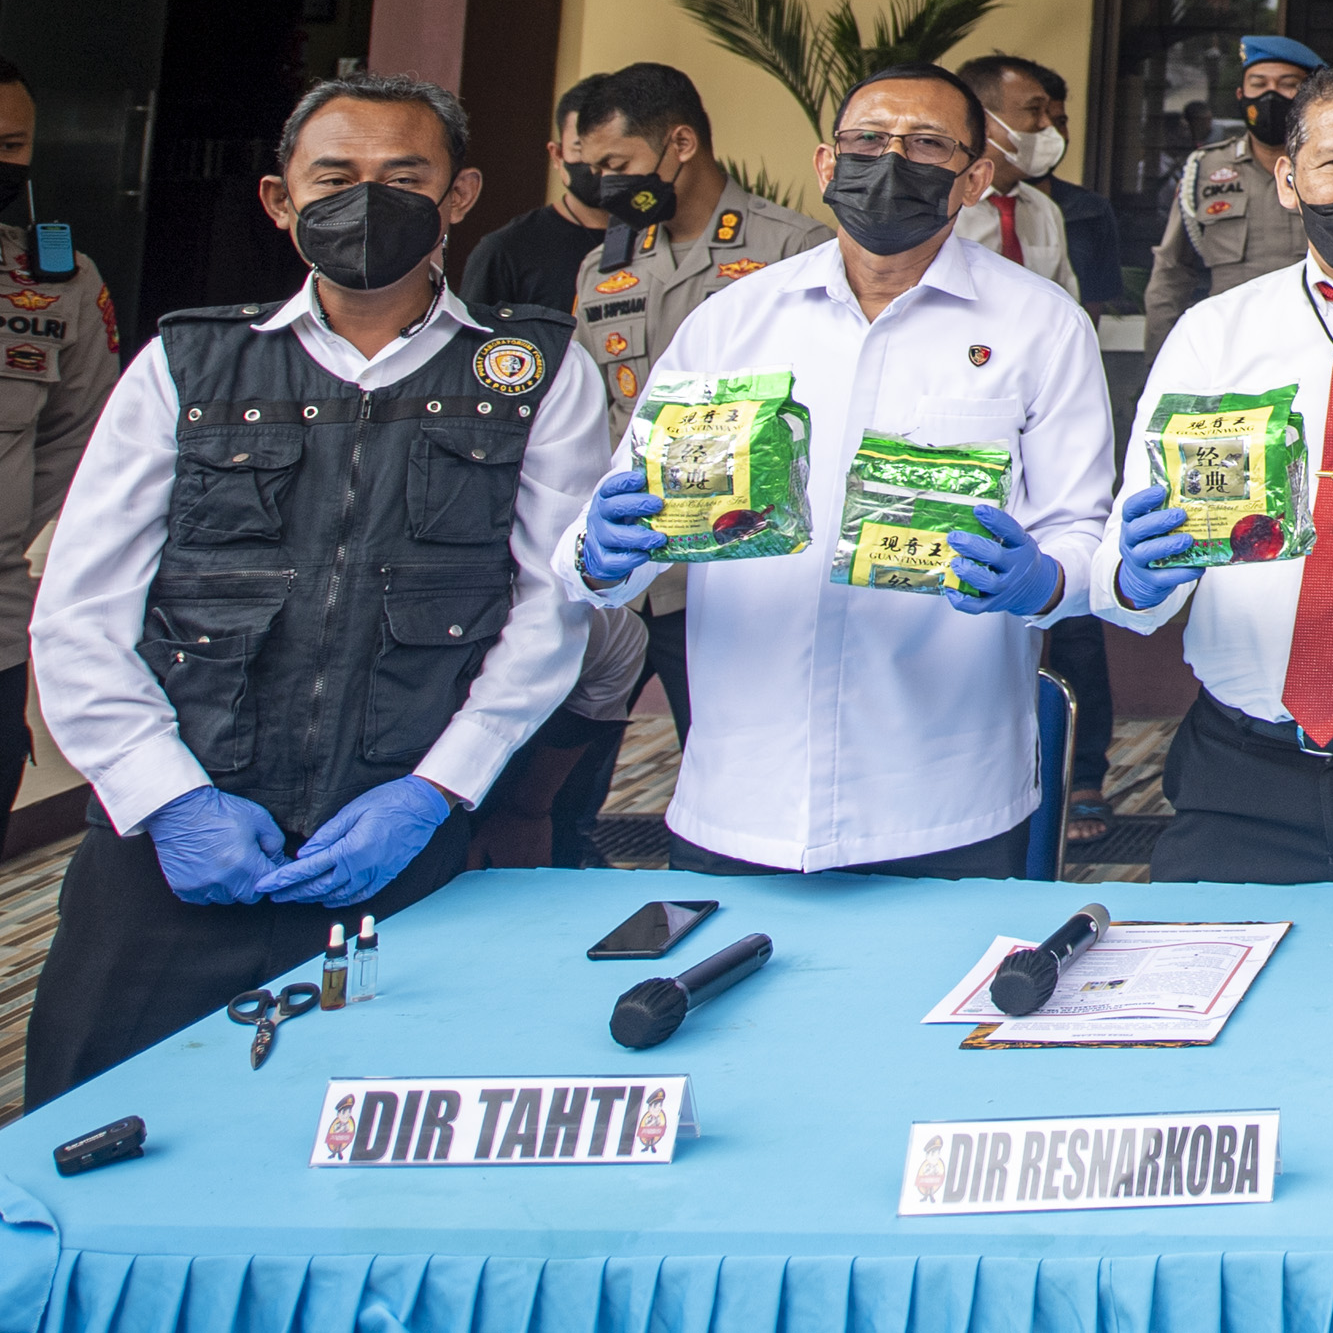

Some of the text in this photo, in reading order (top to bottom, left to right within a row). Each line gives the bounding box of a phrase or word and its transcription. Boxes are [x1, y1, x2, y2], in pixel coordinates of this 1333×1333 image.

[1202, 181, 1244, 198] CIKAL
[481, 339, 533, 355] LABORATORIUM
[492, 382, 526, 393] POLRI
[678, 409, 740, 424] 观音王
[1187, 416, 1246, 429] 观音王
[1196, 446, 1230, 494] 经典
[880, 535, 943, 557] 观音王
[869, 551, 951, 568] GUANYINWANG
[349, 1085, 647, 1163] DIR TAHTI
[942, 1123, 1260, 1204] DIR RESNARKOBA
